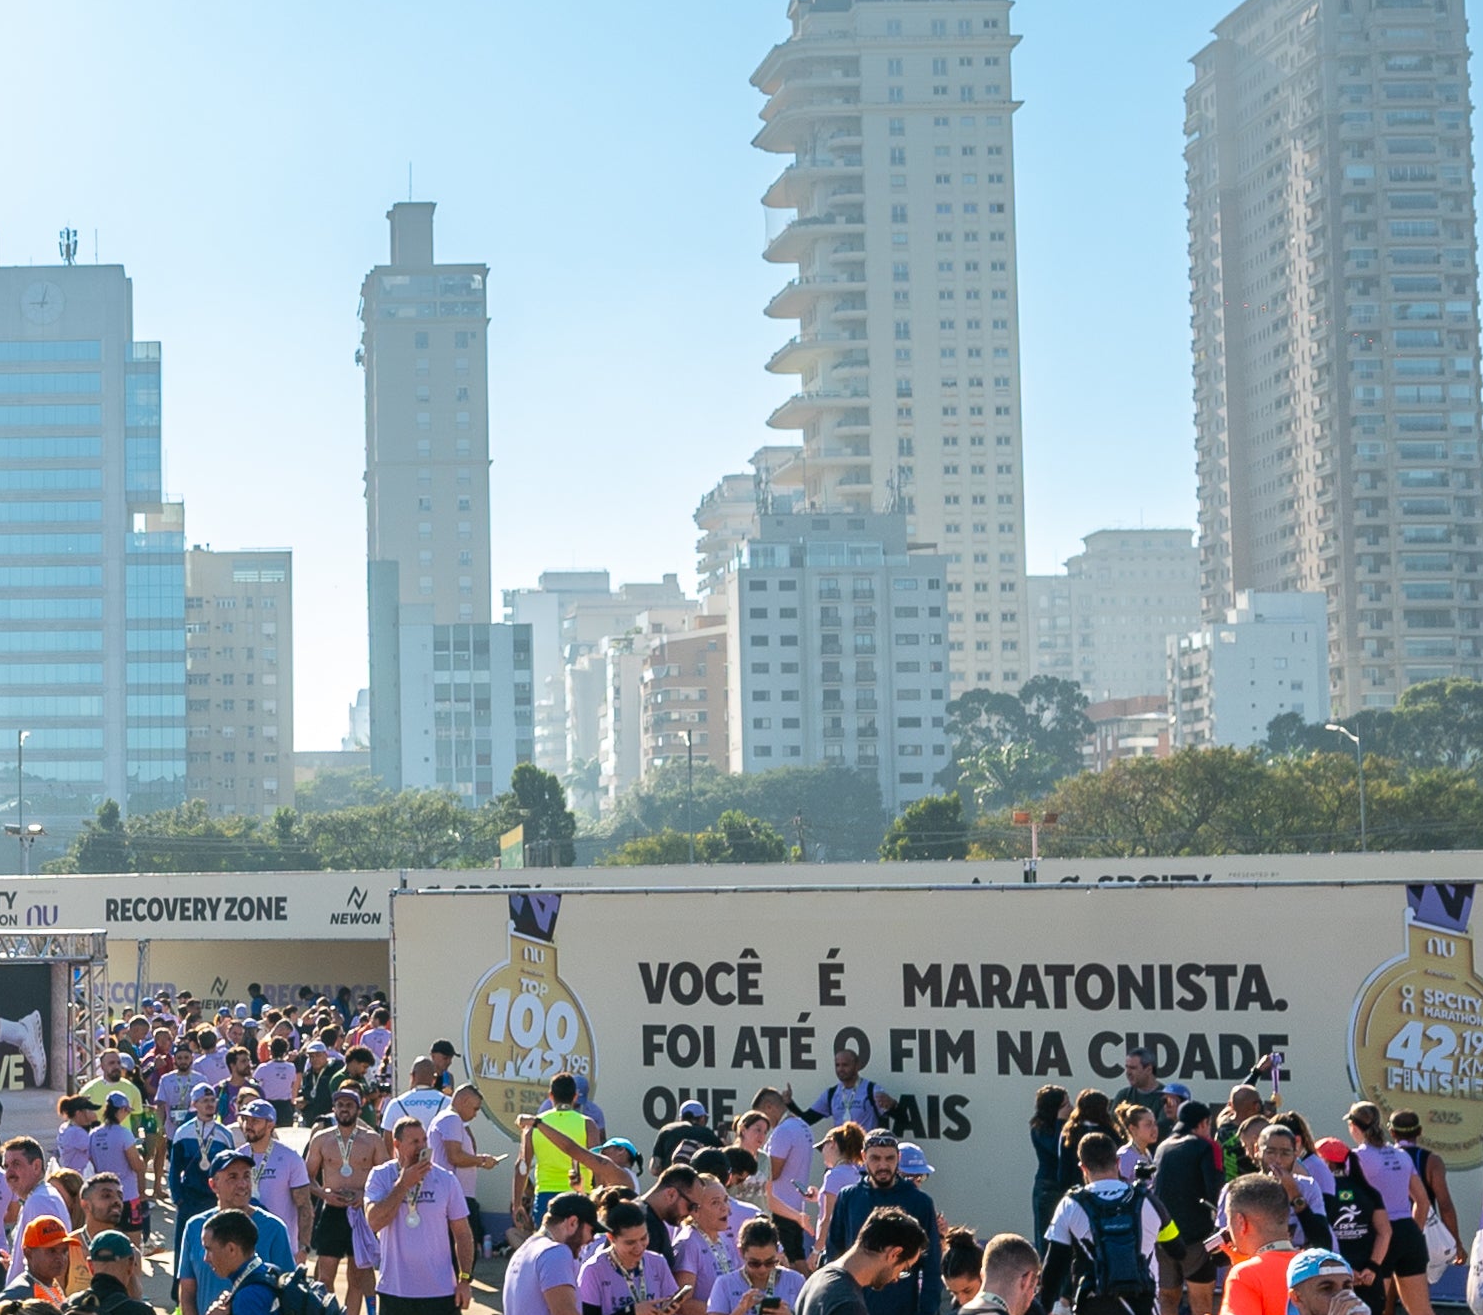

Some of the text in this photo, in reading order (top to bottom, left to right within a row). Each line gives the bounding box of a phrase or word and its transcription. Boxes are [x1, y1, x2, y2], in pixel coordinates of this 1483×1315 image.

[106, 895, 288, 923] RECOVERY ZONE
[331, 912, 382, 925] NEWON
[519, 976, 548, 996] TOP
[638, 947, 1290, 1012] VOCÊ É MARATONISTA.
[1423, 989, 1483, 1013] SPCITY
[487, 987, 579, 1054] 100
[642, 1011, 1292, 1083] FOI ATÉ O FIM NA CIDADE
[888, 1093, 972, 1142] AIS
